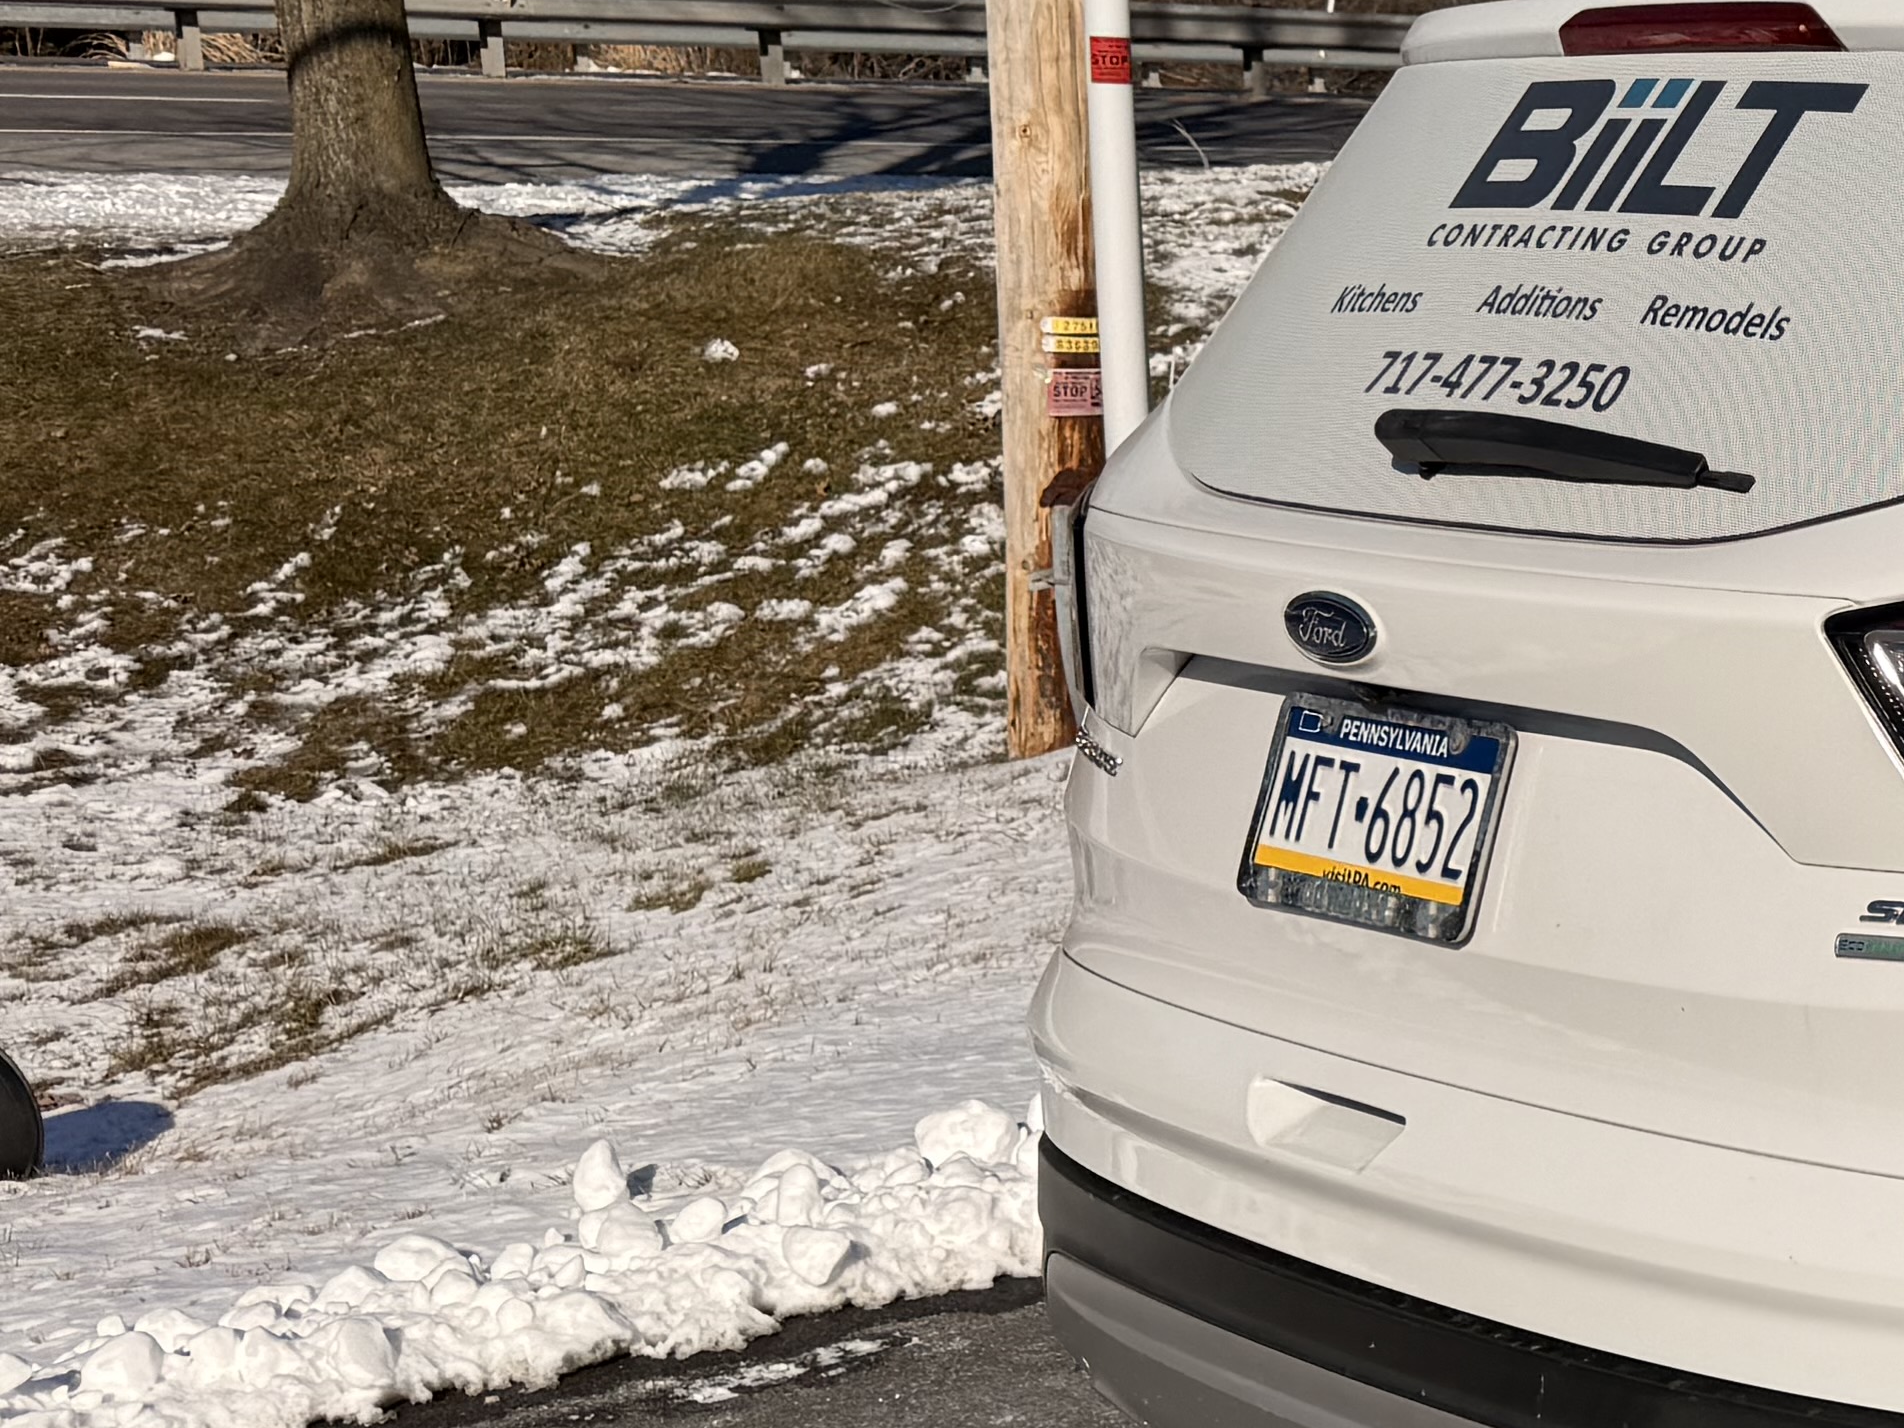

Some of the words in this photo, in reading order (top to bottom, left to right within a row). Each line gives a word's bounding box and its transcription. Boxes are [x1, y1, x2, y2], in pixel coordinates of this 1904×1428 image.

[1427, 223, 1631, 252] CONTRACTING
[1646, 231, 1767, 264] GROUP
[1331, 283, 1423, 313] Kitchens
[1475, 284, 1604, 321] Additions
[1639, 295, 1791, 341] Remodels
[1053, 385, 1088, 397] STOP
[1364, 350, 1631, 413] 717-477-3250
[1299, 606, 1347, 647] Ford
[1340, 718, 1448, 758] PENNSYLVANIA
